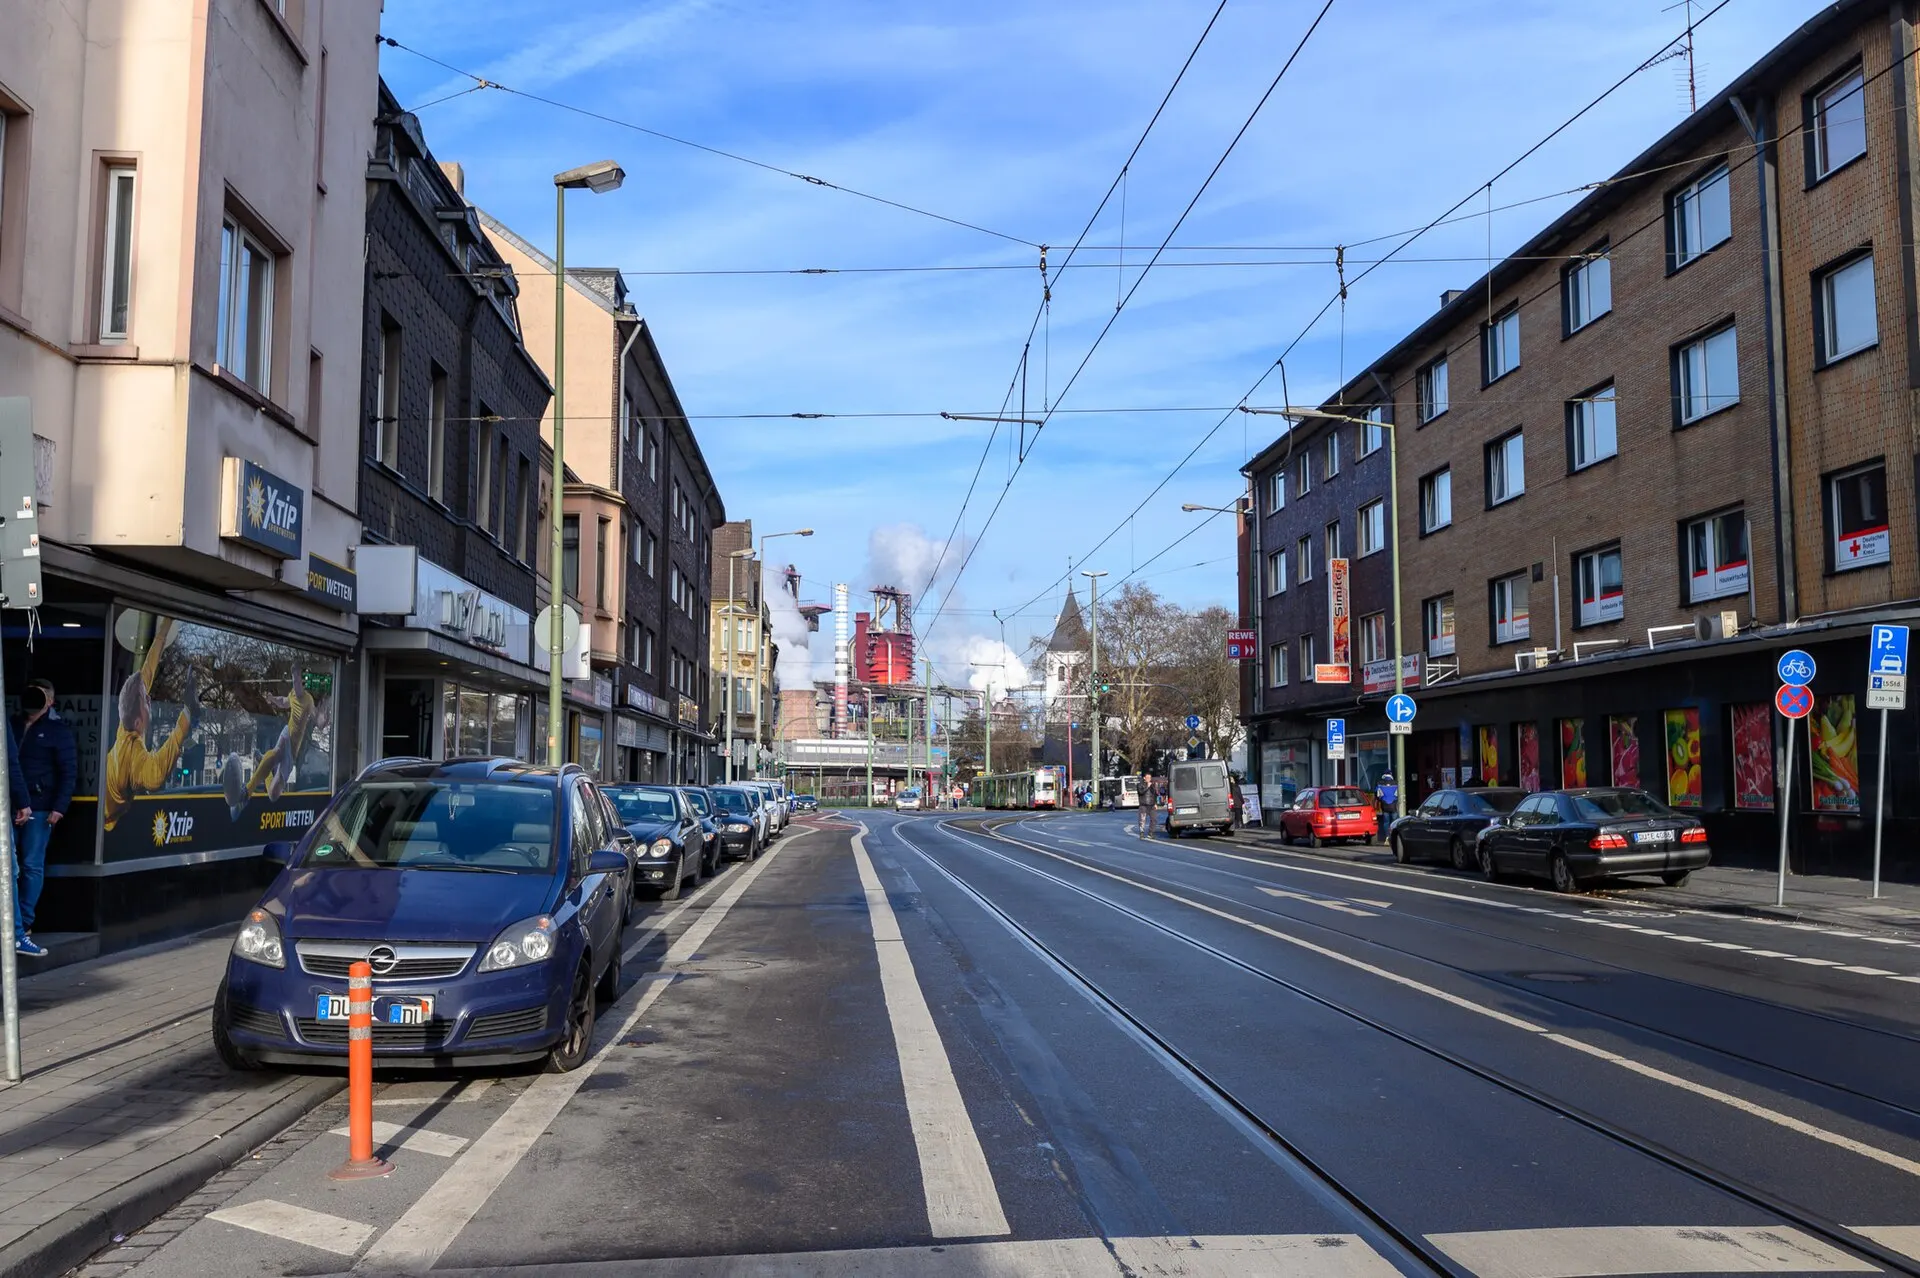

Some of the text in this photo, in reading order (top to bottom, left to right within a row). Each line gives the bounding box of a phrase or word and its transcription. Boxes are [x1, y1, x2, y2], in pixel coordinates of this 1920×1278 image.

[1228, 631, 1255, 640] REWE
[1877, 628, 1894, 649] P
[1329, 720, 1338, 731] P
[260, 810, 315, 830] SPORTWETTEN
